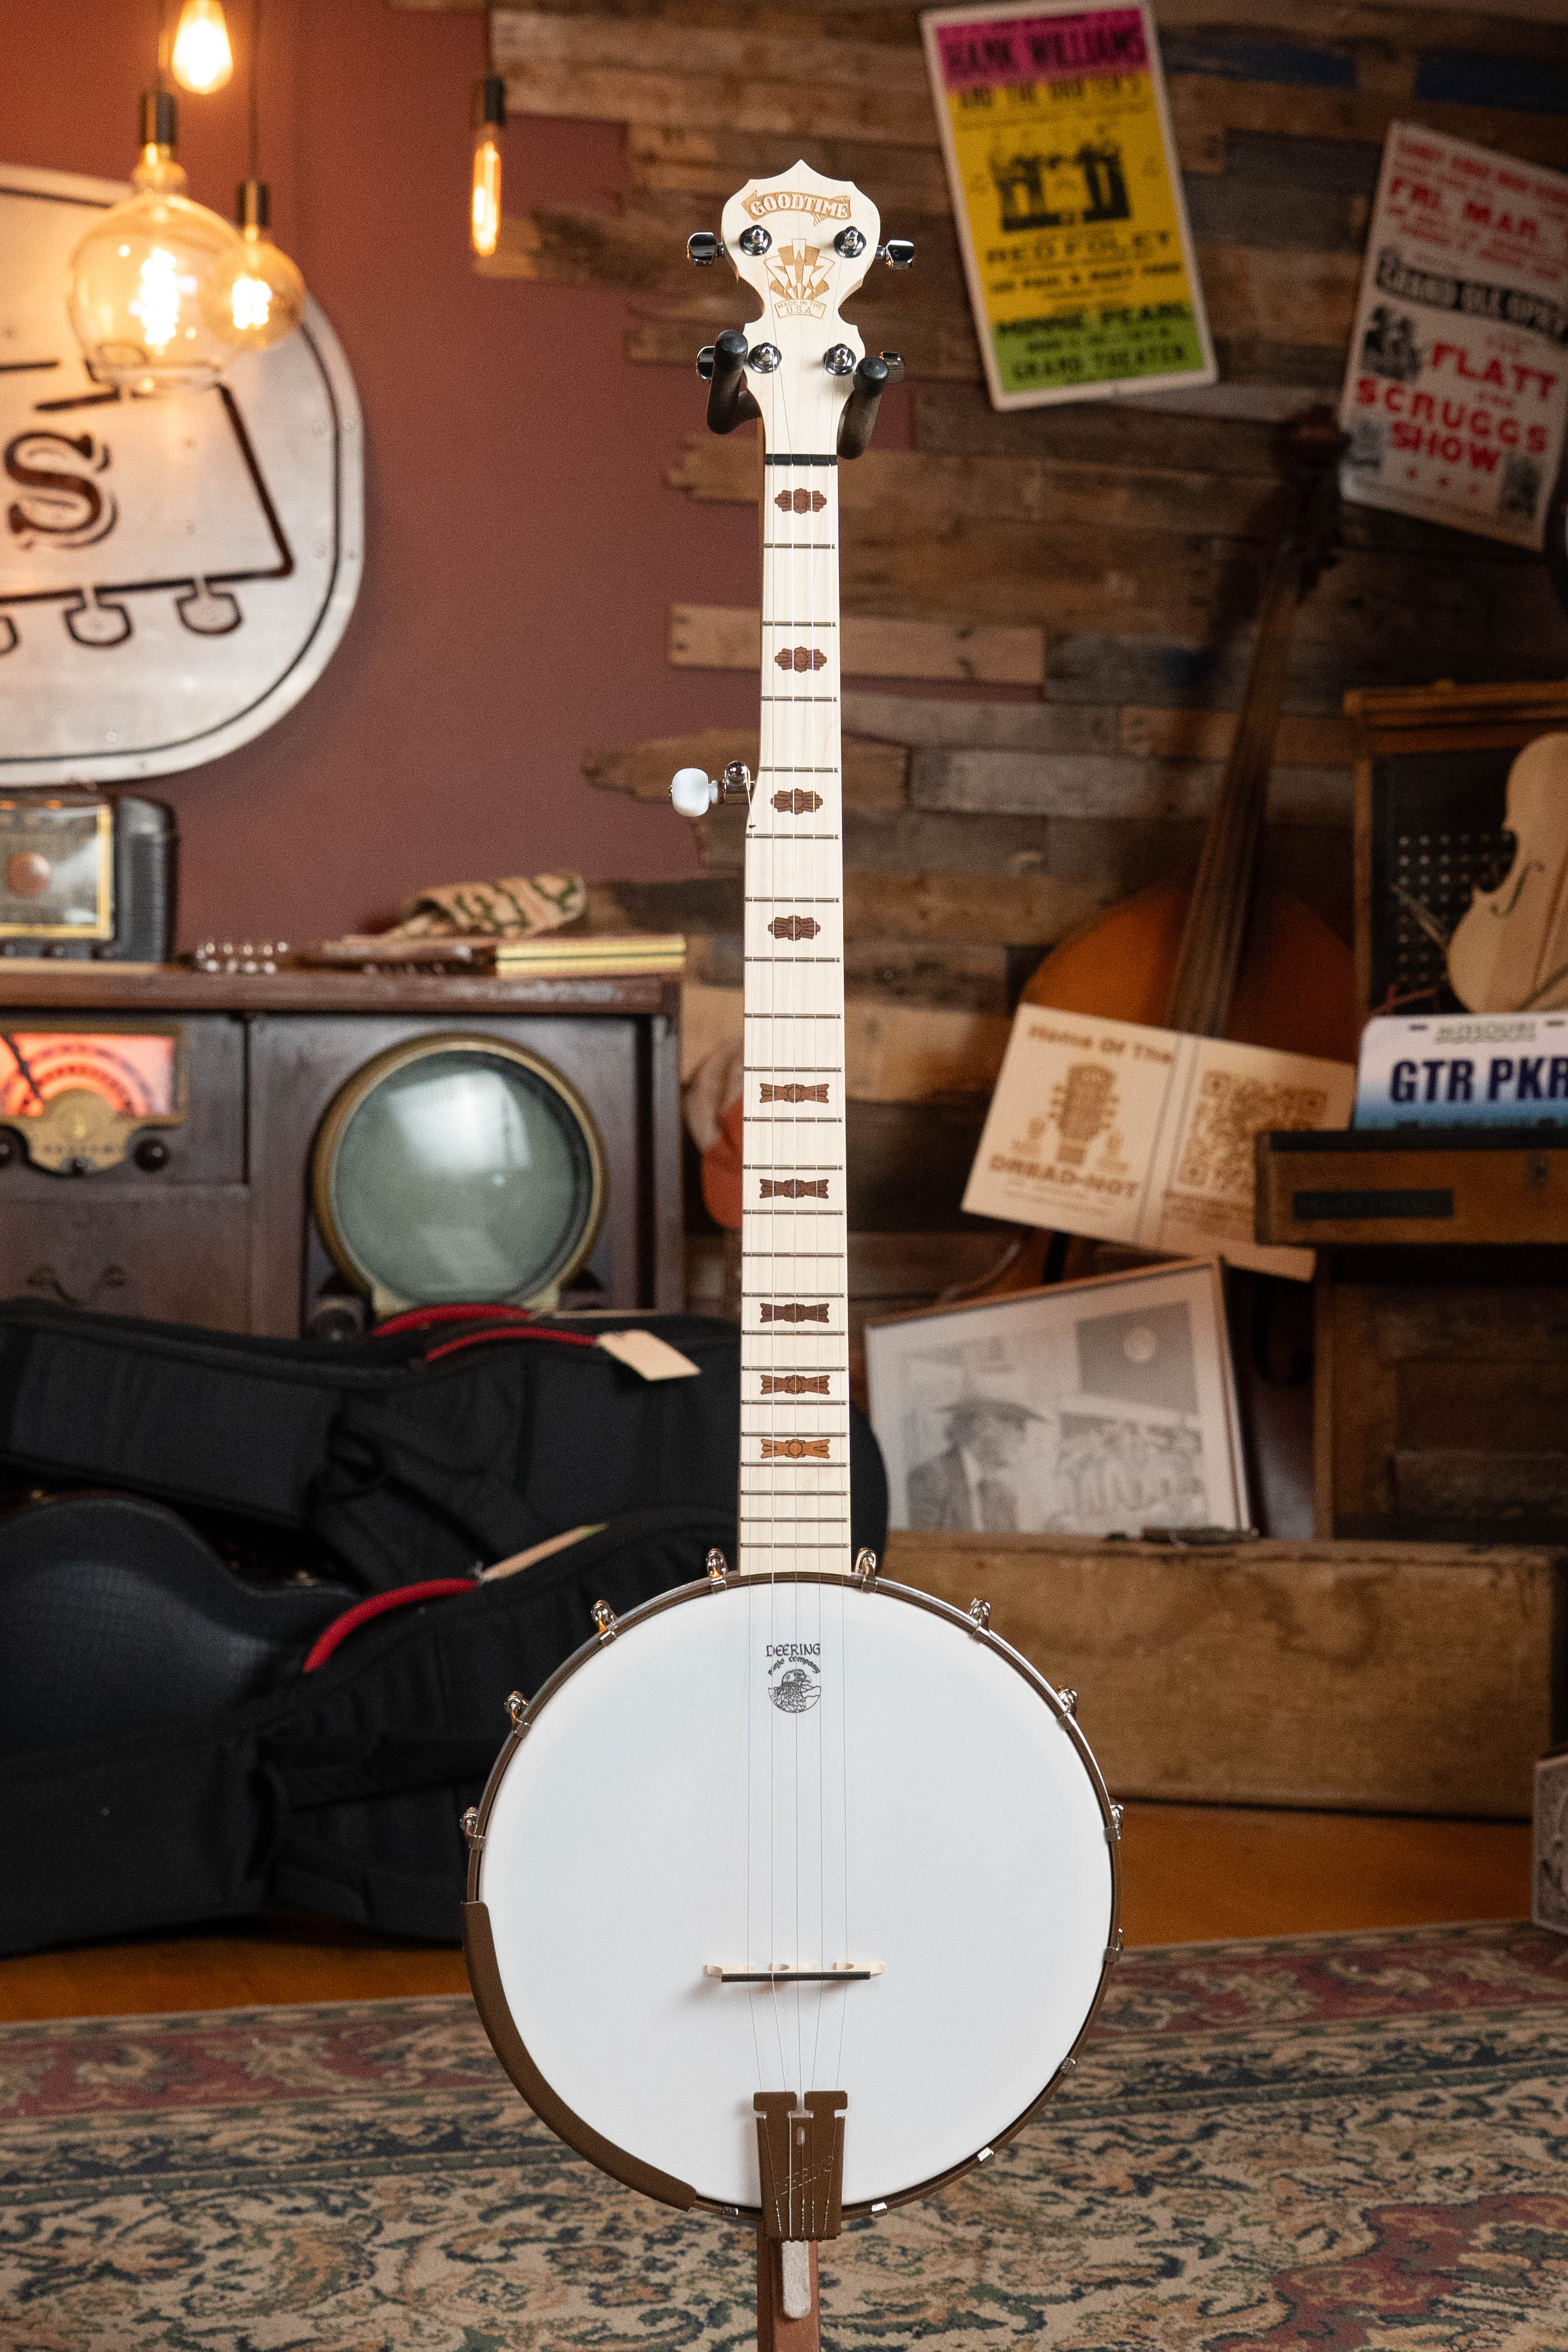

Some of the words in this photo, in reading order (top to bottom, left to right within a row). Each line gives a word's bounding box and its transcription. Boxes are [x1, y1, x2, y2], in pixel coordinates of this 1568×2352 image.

[749, 194, 849, 218] GOODTIME
[777, 300, 797, 309] MADE
[810, 301, 823, 310] THE
[786, 305, 813, 316] U.S.A.
[1431, 341, 1559, 401] FLATT
[1355, 376, 1549, 455] SCRUGGS
[1389, 419, 1503, 474] SHOW
[1390, 1059, 1476, 1104] GTR
[1488, 1056, 1568, 1102] PKR
[765, 1643, 821, 1657] DEERING
